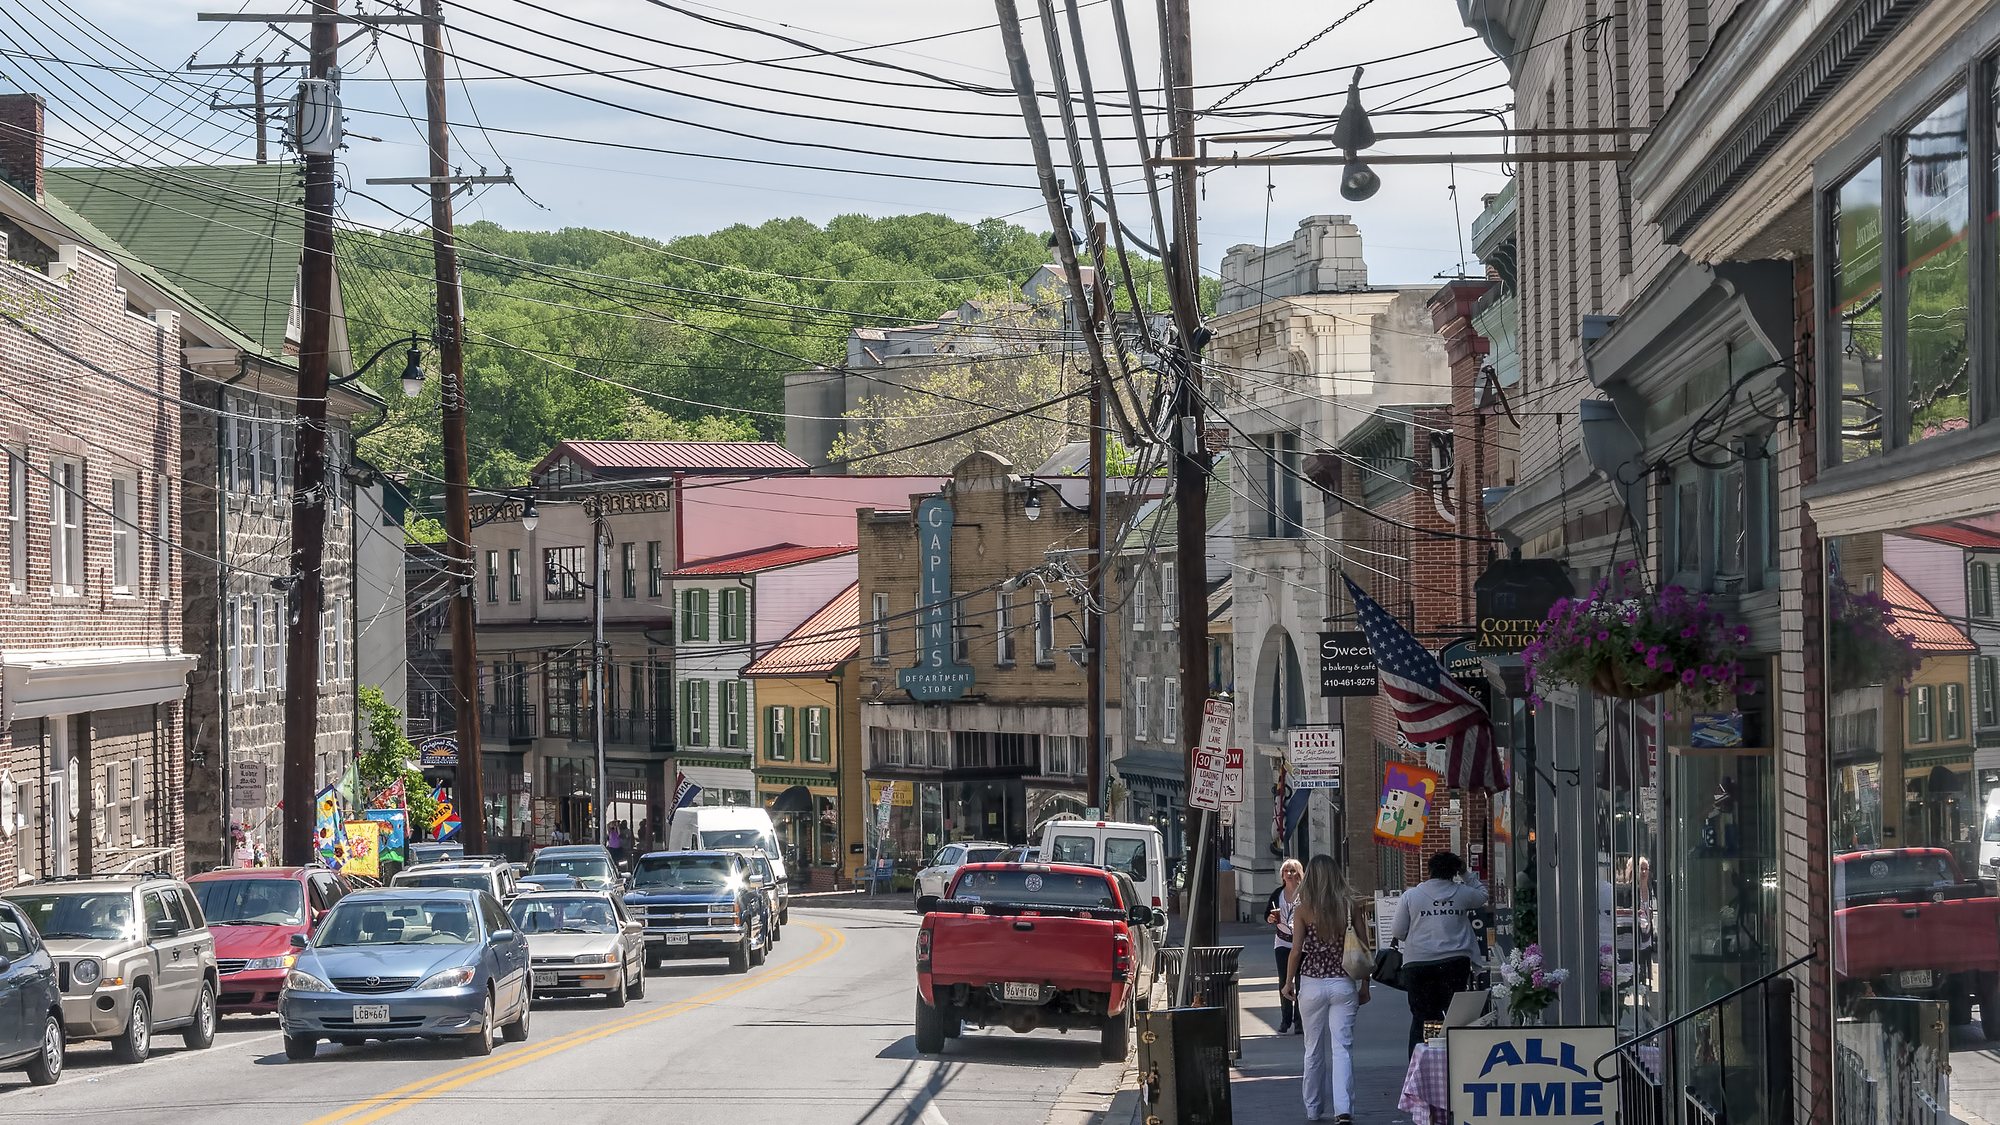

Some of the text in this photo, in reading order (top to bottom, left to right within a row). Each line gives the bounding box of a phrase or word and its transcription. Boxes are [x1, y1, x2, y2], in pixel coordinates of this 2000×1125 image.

[928, 507, 943, 667] CAPLAN'S
[1328, 662, 1353, 673] bakery
[1353, 663, 1360, 671] &
[905, 673, 970, 683] DEPARTMENT
[1324, 678, 1376, 687] 410-461-9275
[922, 685, 953, 694] STORE
[1207, 716, 1228, 726] ANYTIME
[1208, 735, 1221, 745] LANE
[1198, 755, 1210, 767] 30
[1200, 770, 1219, 781] LOADING
[1202, 779, 1215, 789] ZONE
[1479, 1038, 1588, 1079] ALL
[1463, 1081, 1604, 1117] TIME
